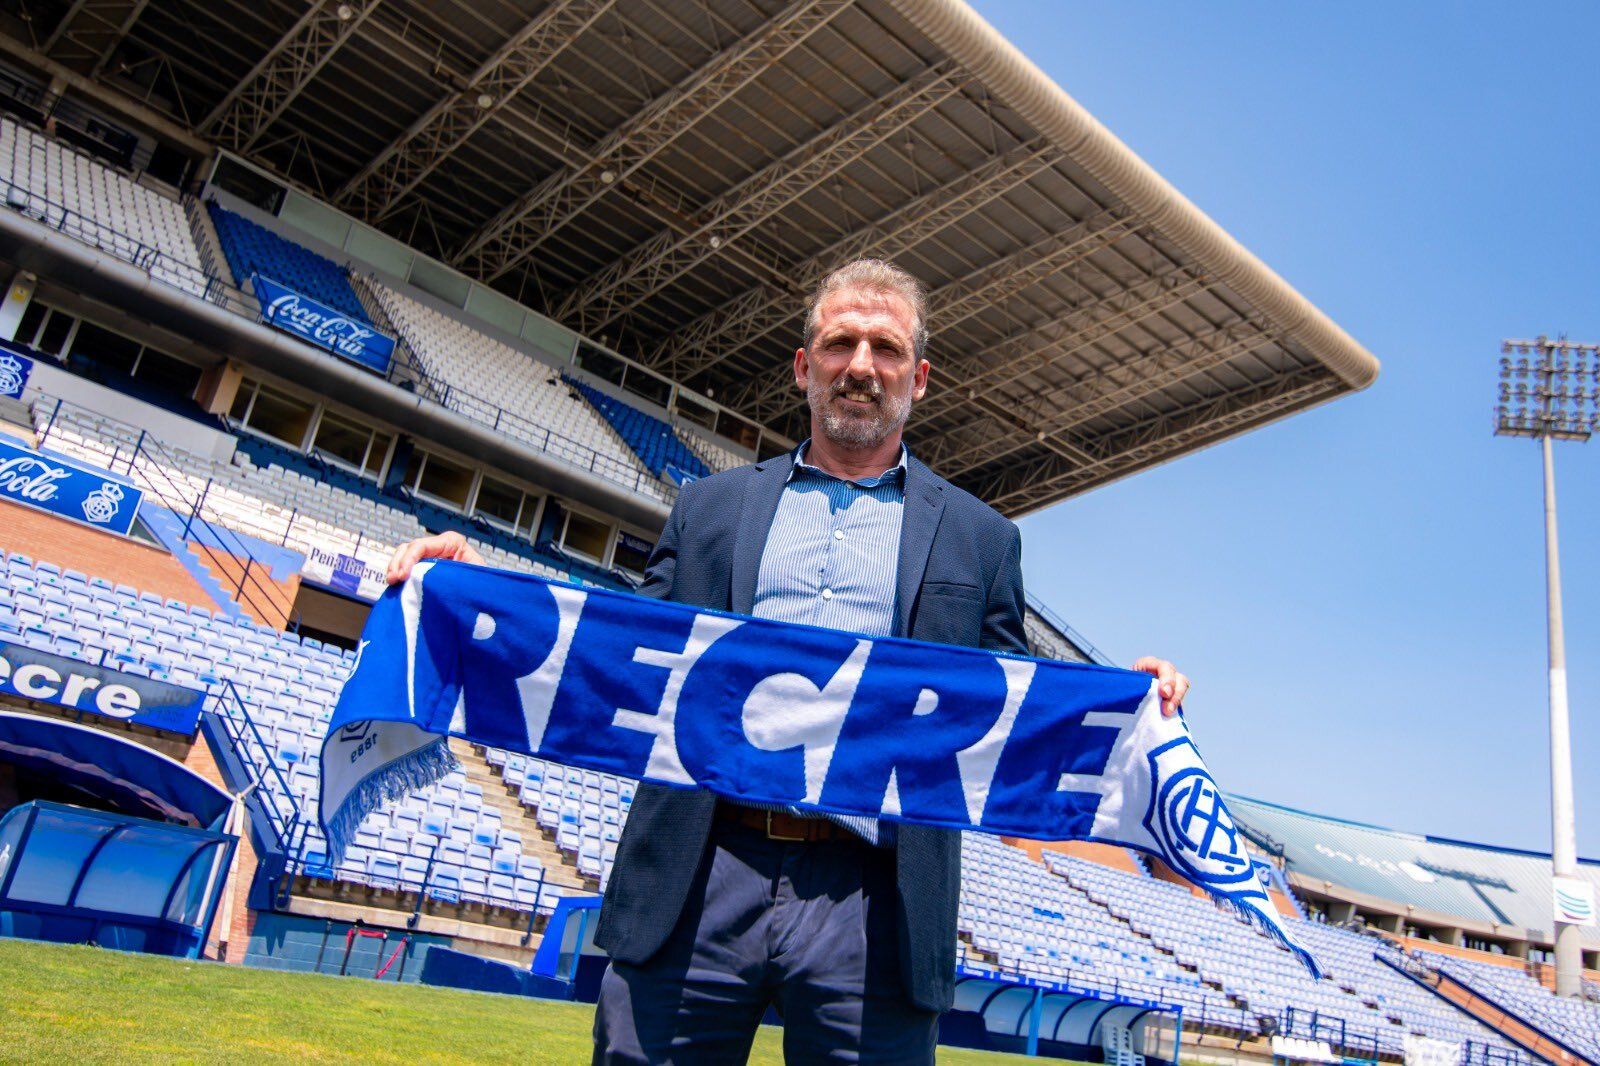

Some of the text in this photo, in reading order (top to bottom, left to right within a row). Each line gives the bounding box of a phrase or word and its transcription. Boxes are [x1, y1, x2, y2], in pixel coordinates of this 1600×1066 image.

[268, 295, 375, 356] Coca-Cola
[310, 547, 343, 571] Peña
[0, 655, 141, 718] cre
[413, 560, 1154, 839] RECRE
